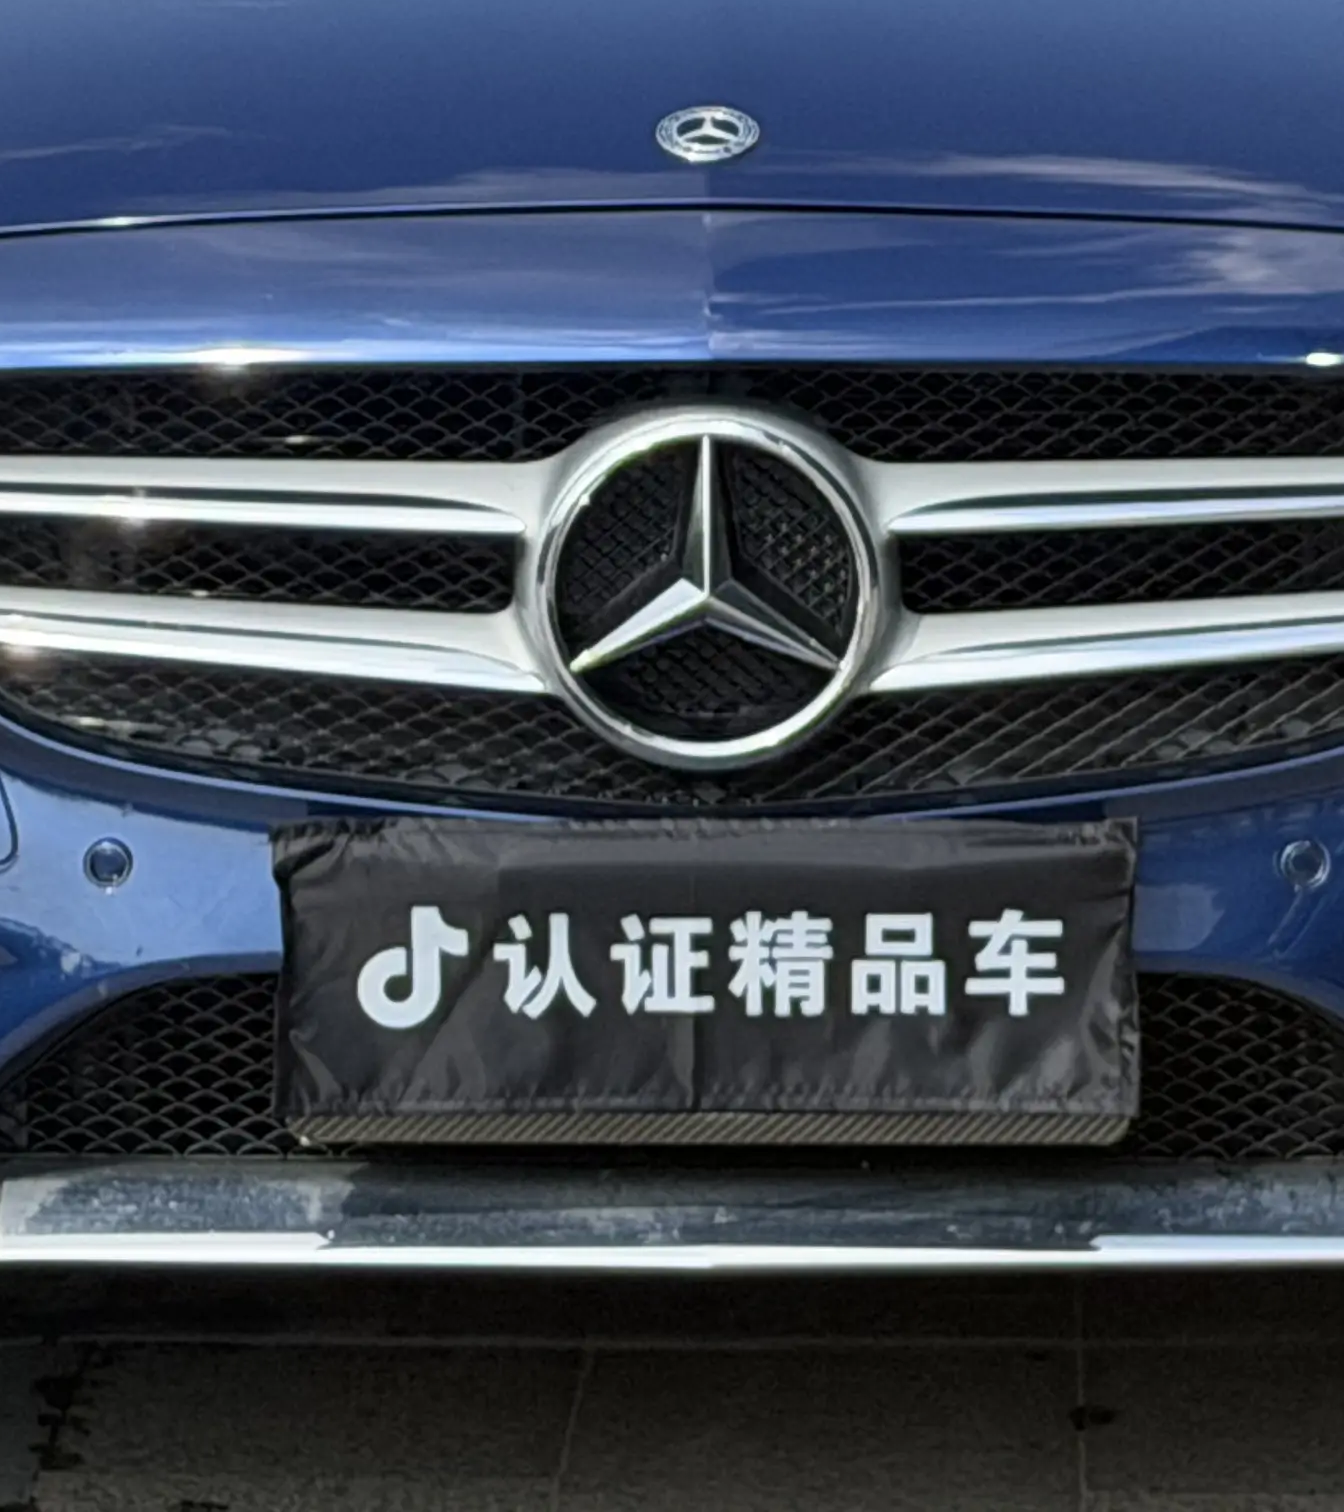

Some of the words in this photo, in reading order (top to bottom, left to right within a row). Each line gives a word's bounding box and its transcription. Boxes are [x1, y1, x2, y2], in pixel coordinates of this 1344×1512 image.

[493, 909, 1066, 1019] 认证精品车
